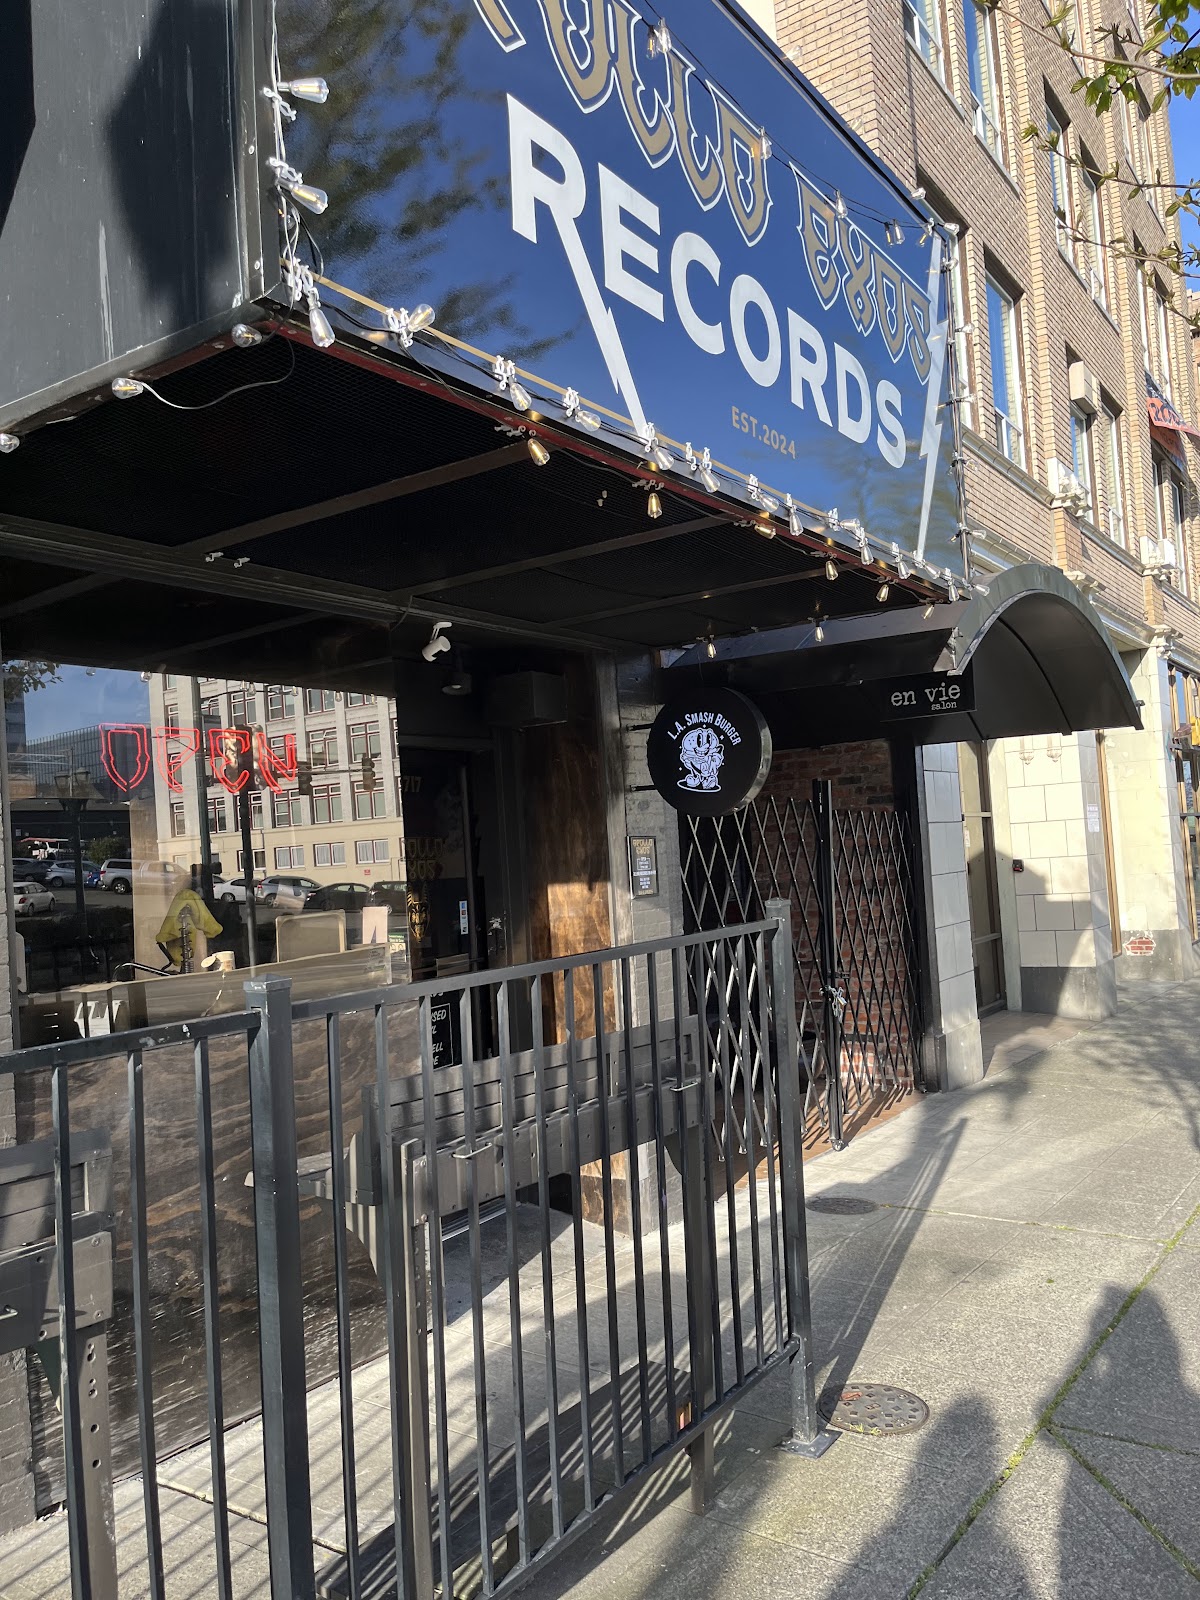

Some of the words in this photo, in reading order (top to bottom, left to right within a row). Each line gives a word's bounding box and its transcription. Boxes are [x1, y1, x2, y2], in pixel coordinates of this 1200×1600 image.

[473, 0, 774, 247] OLLO
[507, 93, 906, 468] RECORDS
[731, 405, 796, 460] EST.2024
[891, 690, 917, 706] en
[924, 682, 961, 702] vie
[99, 723, 297, 795] OPEN
[667, 721, 686, 740] L.A.
[685, 712, 714, 726] SMASH
[714, 713, 741, 746] BURGER
